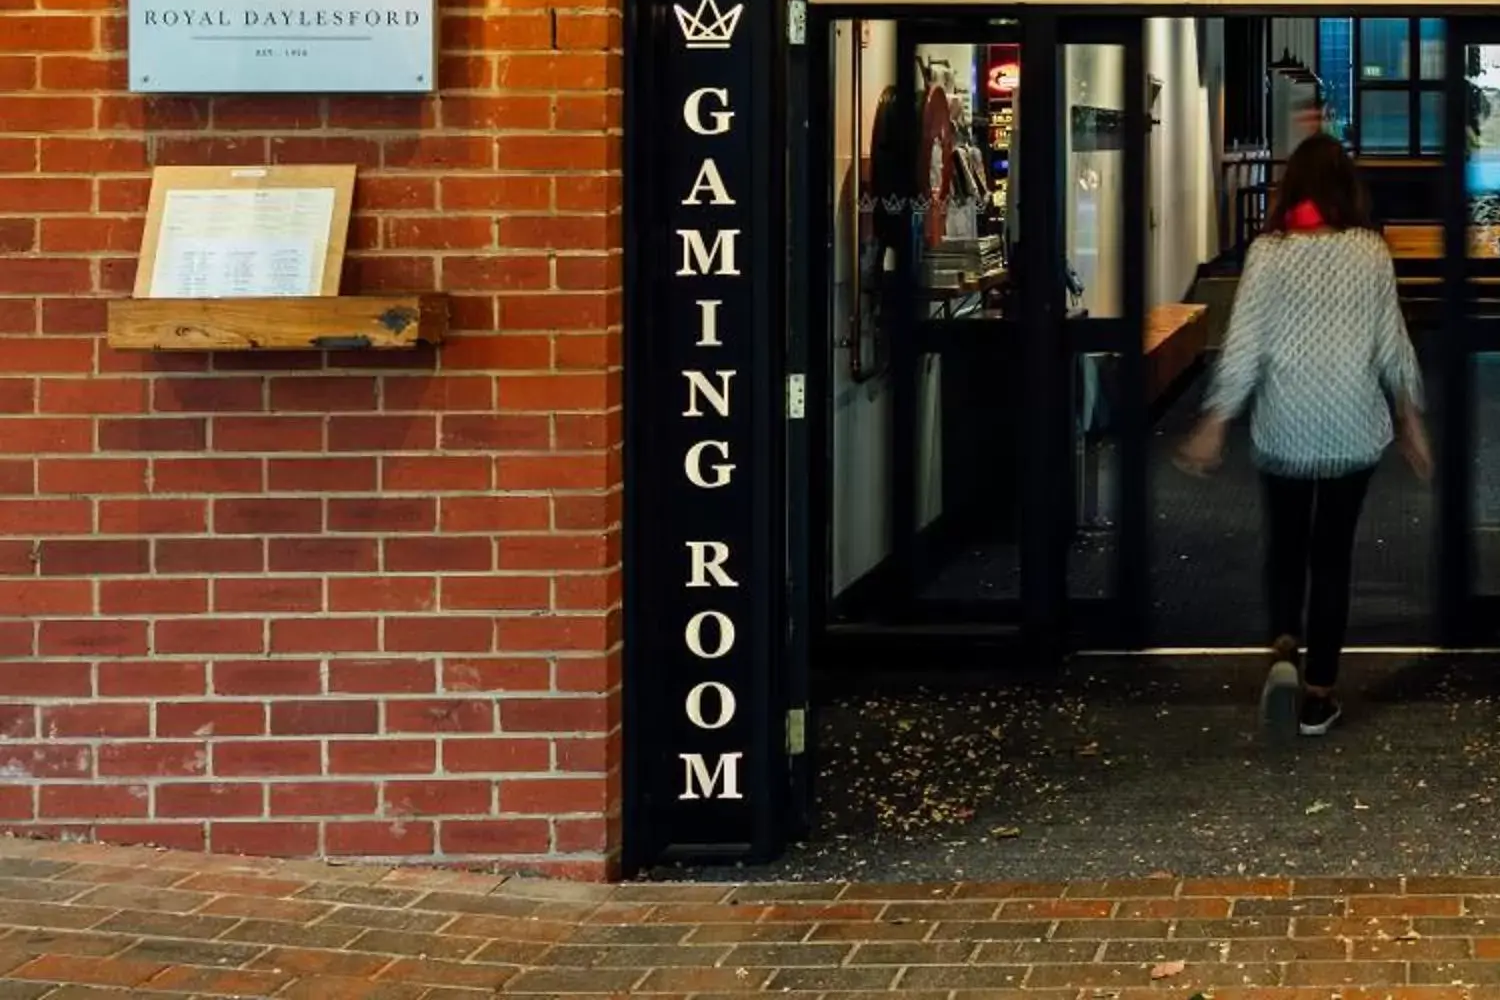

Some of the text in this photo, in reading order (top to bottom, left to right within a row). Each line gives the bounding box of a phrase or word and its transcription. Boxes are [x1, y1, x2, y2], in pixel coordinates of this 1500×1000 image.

[144, 9, 420, 27] ROYAL DAYLESFORD
[675, 86, 744, 801] GAMING ROOM
